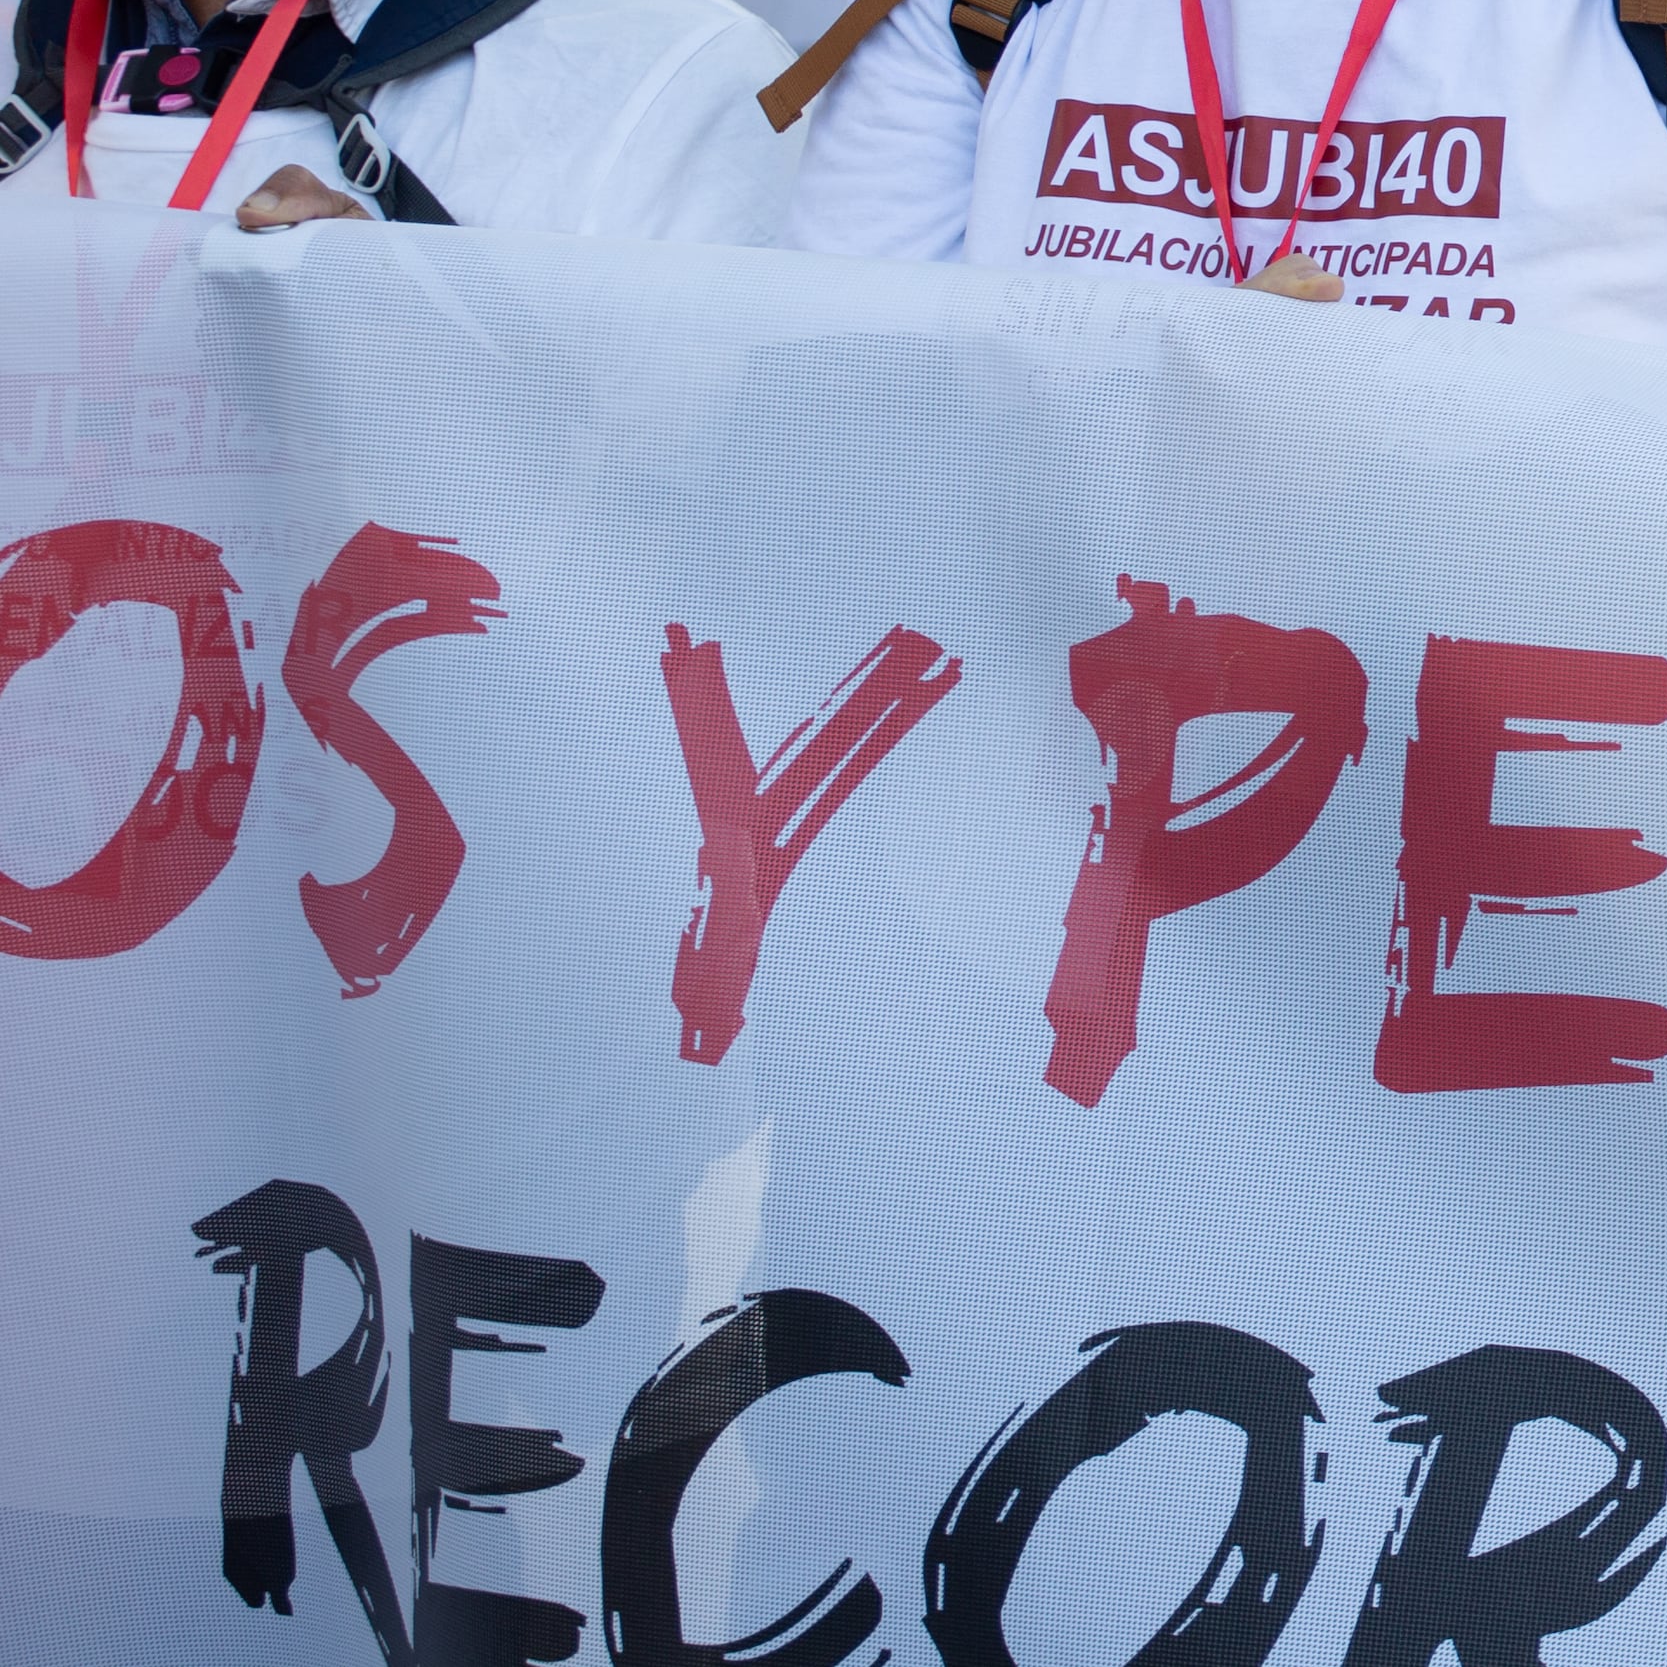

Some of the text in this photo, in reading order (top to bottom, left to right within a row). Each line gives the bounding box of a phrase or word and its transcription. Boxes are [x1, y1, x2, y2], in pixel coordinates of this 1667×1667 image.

[1050, 114, 1483, 210] ASJUBI40
[1024, 222, 1496, 280] JUBILACIÓN TICIPADA
[0, 519, 509, 1000] OS
[660, 621, 962, 1067] Y
